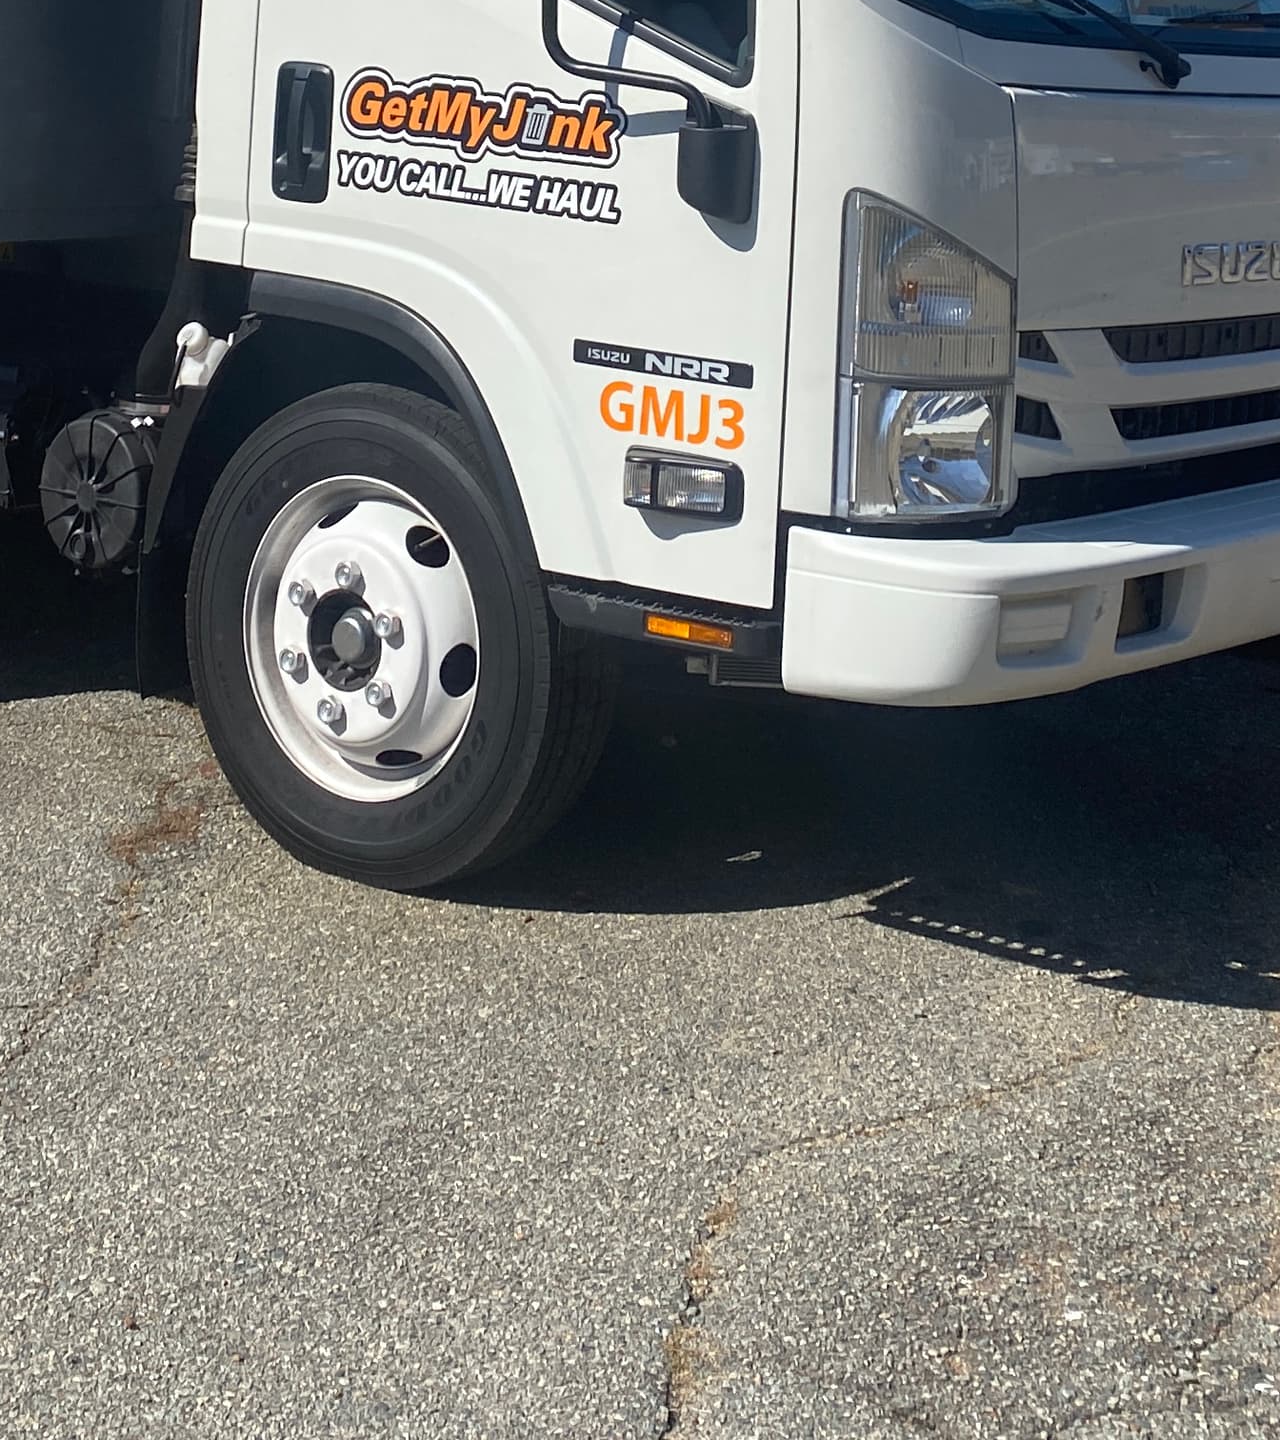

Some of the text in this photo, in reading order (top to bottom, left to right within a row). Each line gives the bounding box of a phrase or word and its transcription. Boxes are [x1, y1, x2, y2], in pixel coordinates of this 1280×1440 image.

[350, 81, 613, 153] GetMyJnk
[339, 153, 396, 188] YOU
[535, 179, 619, 220] HAUL
[587, 347, 730, 383] ISUZU NRR
[600, 381, 745, 450] GMJ3
